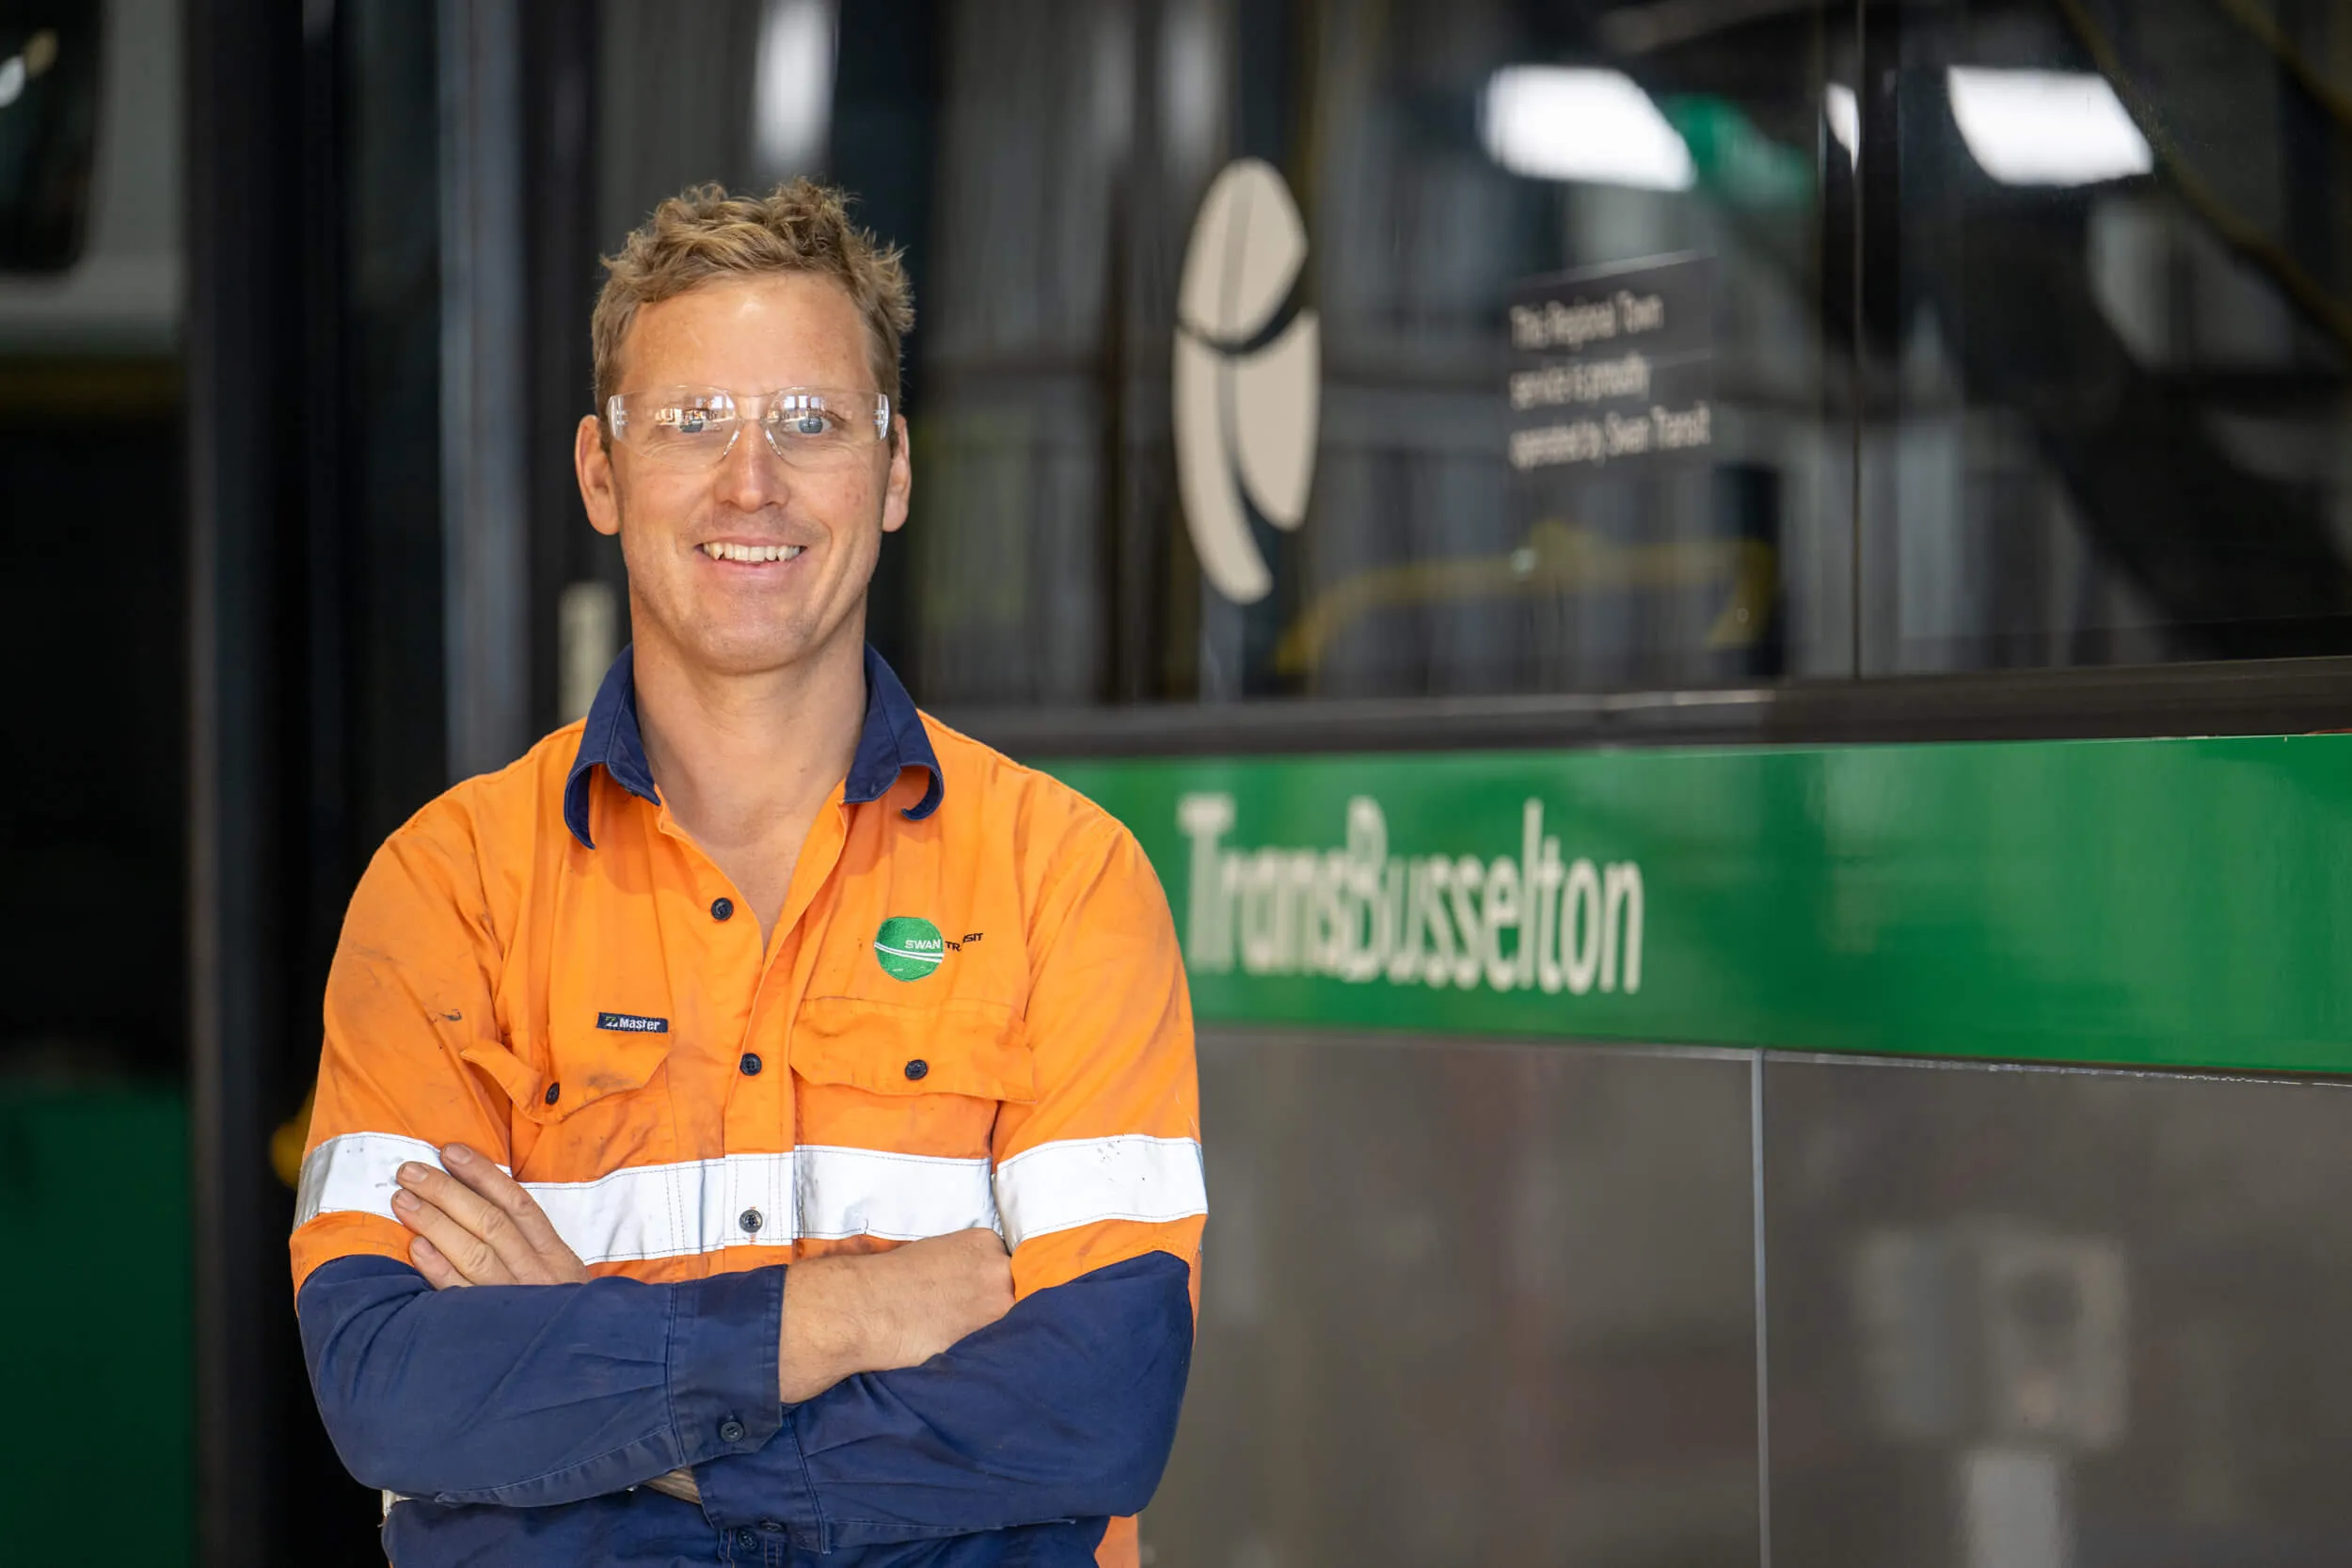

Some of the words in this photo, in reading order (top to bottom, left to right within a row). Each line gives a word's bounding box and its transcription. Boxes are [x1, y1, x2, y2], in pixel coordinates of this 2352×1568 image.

[1616, 290, 1664, 333] Town
[1177, 792, 1644, 994] TransBusselton
[904, 939, 941, 949] SWAN
[945, 932, 983, 952] TRSIT
[619, 1018, 660, 1031] Master
